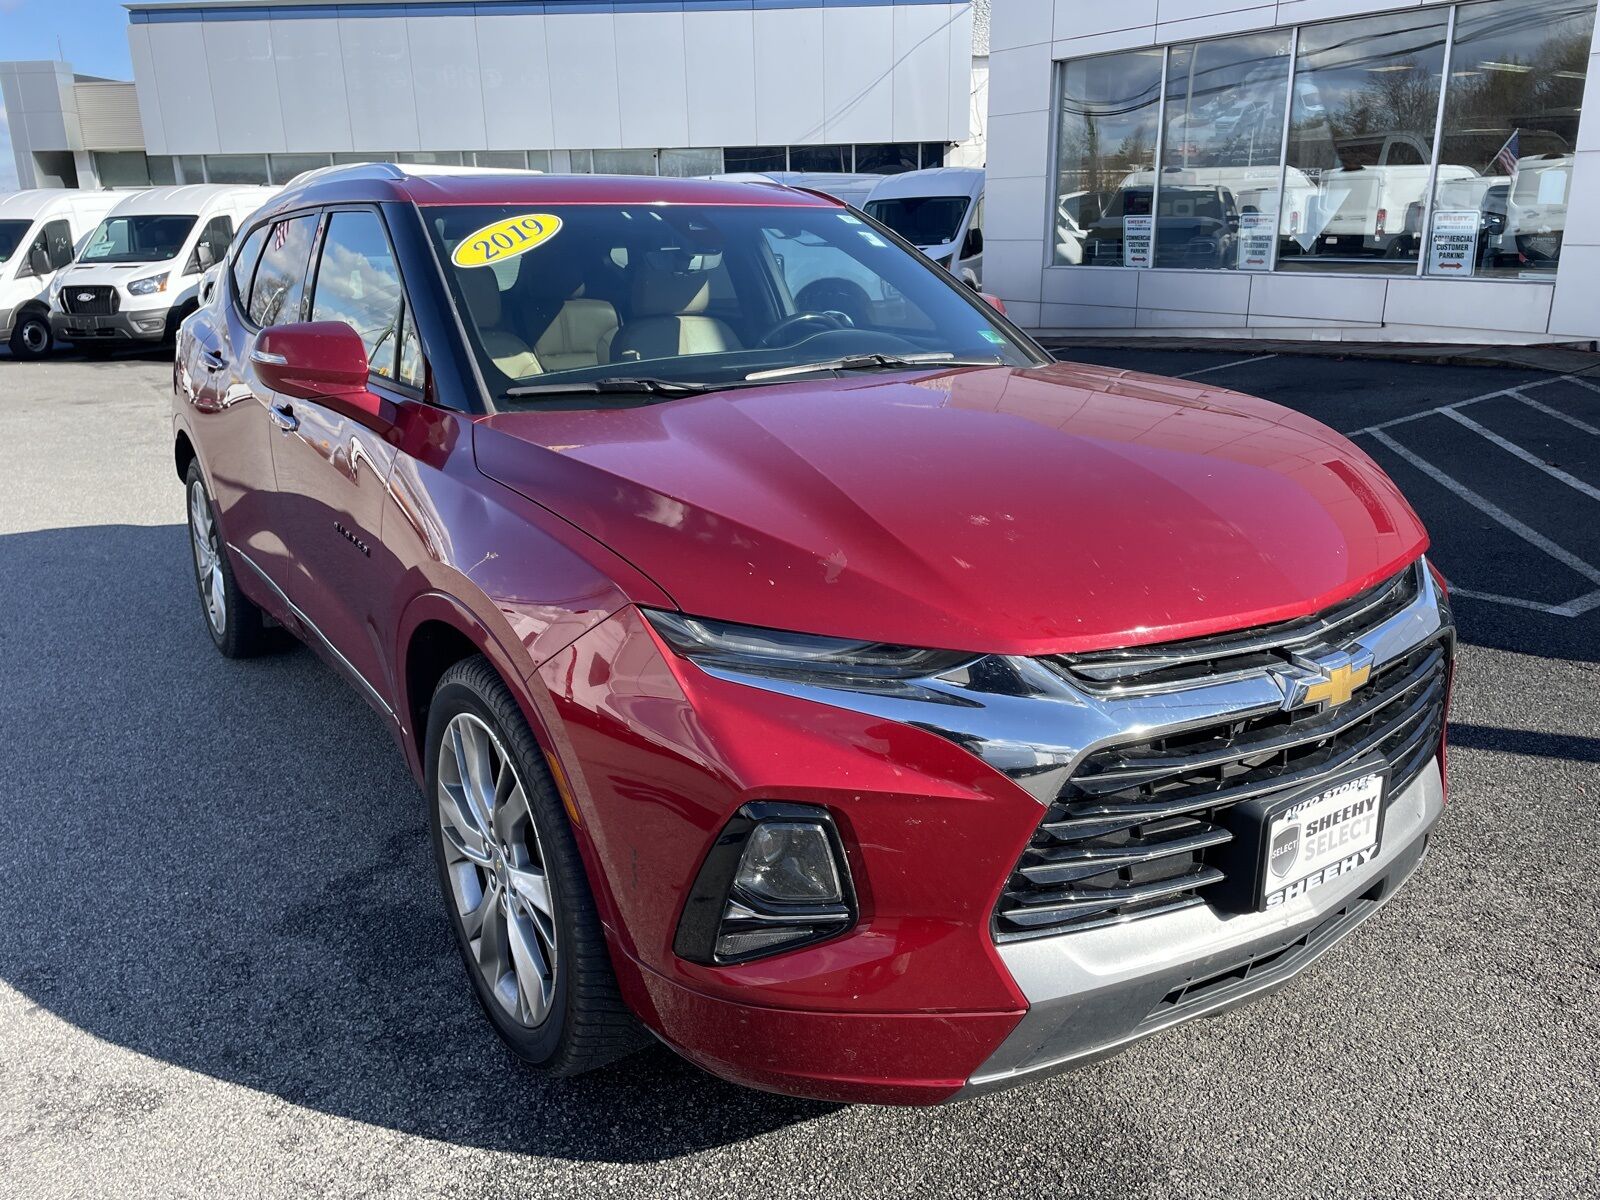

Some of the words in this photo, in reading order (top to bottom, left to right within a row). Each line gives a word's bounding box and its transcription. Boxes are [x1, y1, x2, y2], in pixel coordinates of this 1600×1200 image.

[473, 219, 544, 259] 2019
[1436, 243, 1469, 251] CUSTOMER
[1283, 796, 1320, 822] AUTO
[1323, 774, 1377, 802] STORES
[1305, 795, 1377, 838] SHEEHY
[1271, 840, 1298, 859] SELECT
[1304, 813, 1375, 861] SELECT
[1266, 846, 1378, 910] SHEEHY
